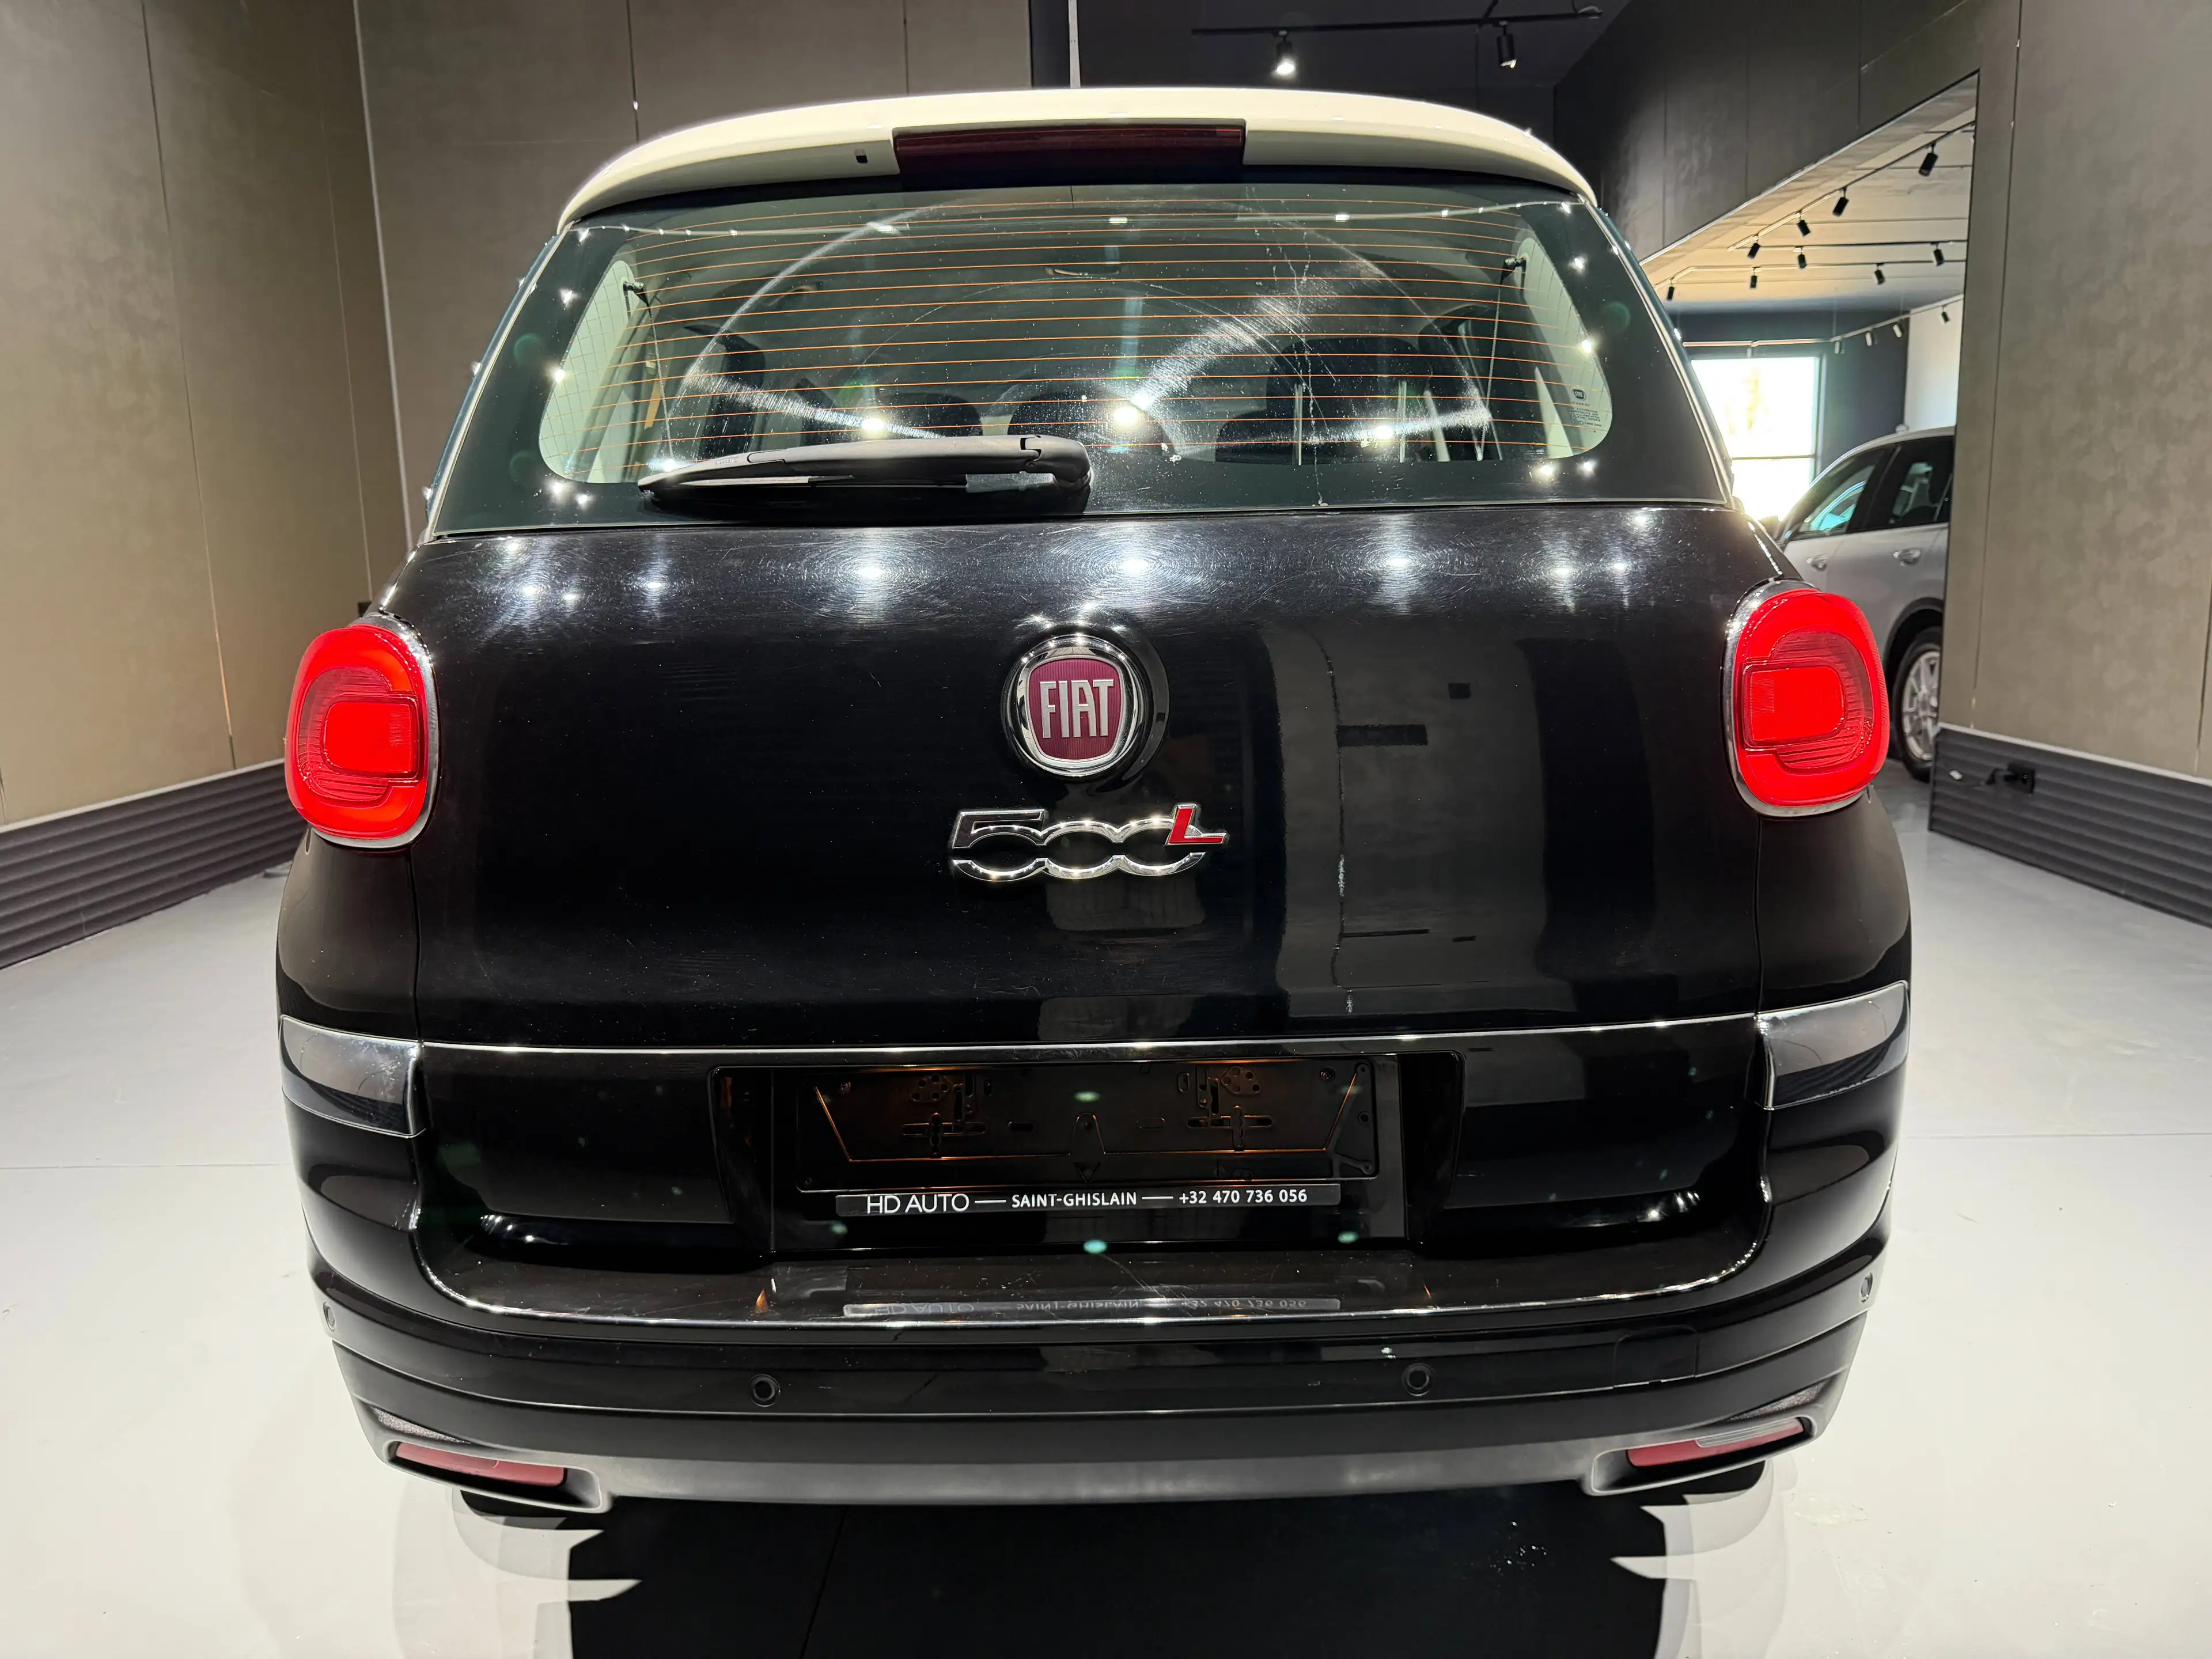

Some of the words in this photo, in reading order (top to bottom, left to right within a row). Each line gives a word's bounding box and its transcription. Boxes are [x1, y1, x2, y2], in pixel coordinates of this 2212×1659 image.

[1039, 679, 1115, 739] FIAT
[866, 1195, 901, 1214] HD
[904, 1193, 969, 1213] AUTO
[1012, 1192, 1137, 1208] SAINT-GHISLAIN
[1179, 1191, 1207, 1205] +32
[1212, 1190, 1240, 1204] 470
[1246, 1190, 1274, 1203] 736
[1279, 1189, 1308, 1203] 056
